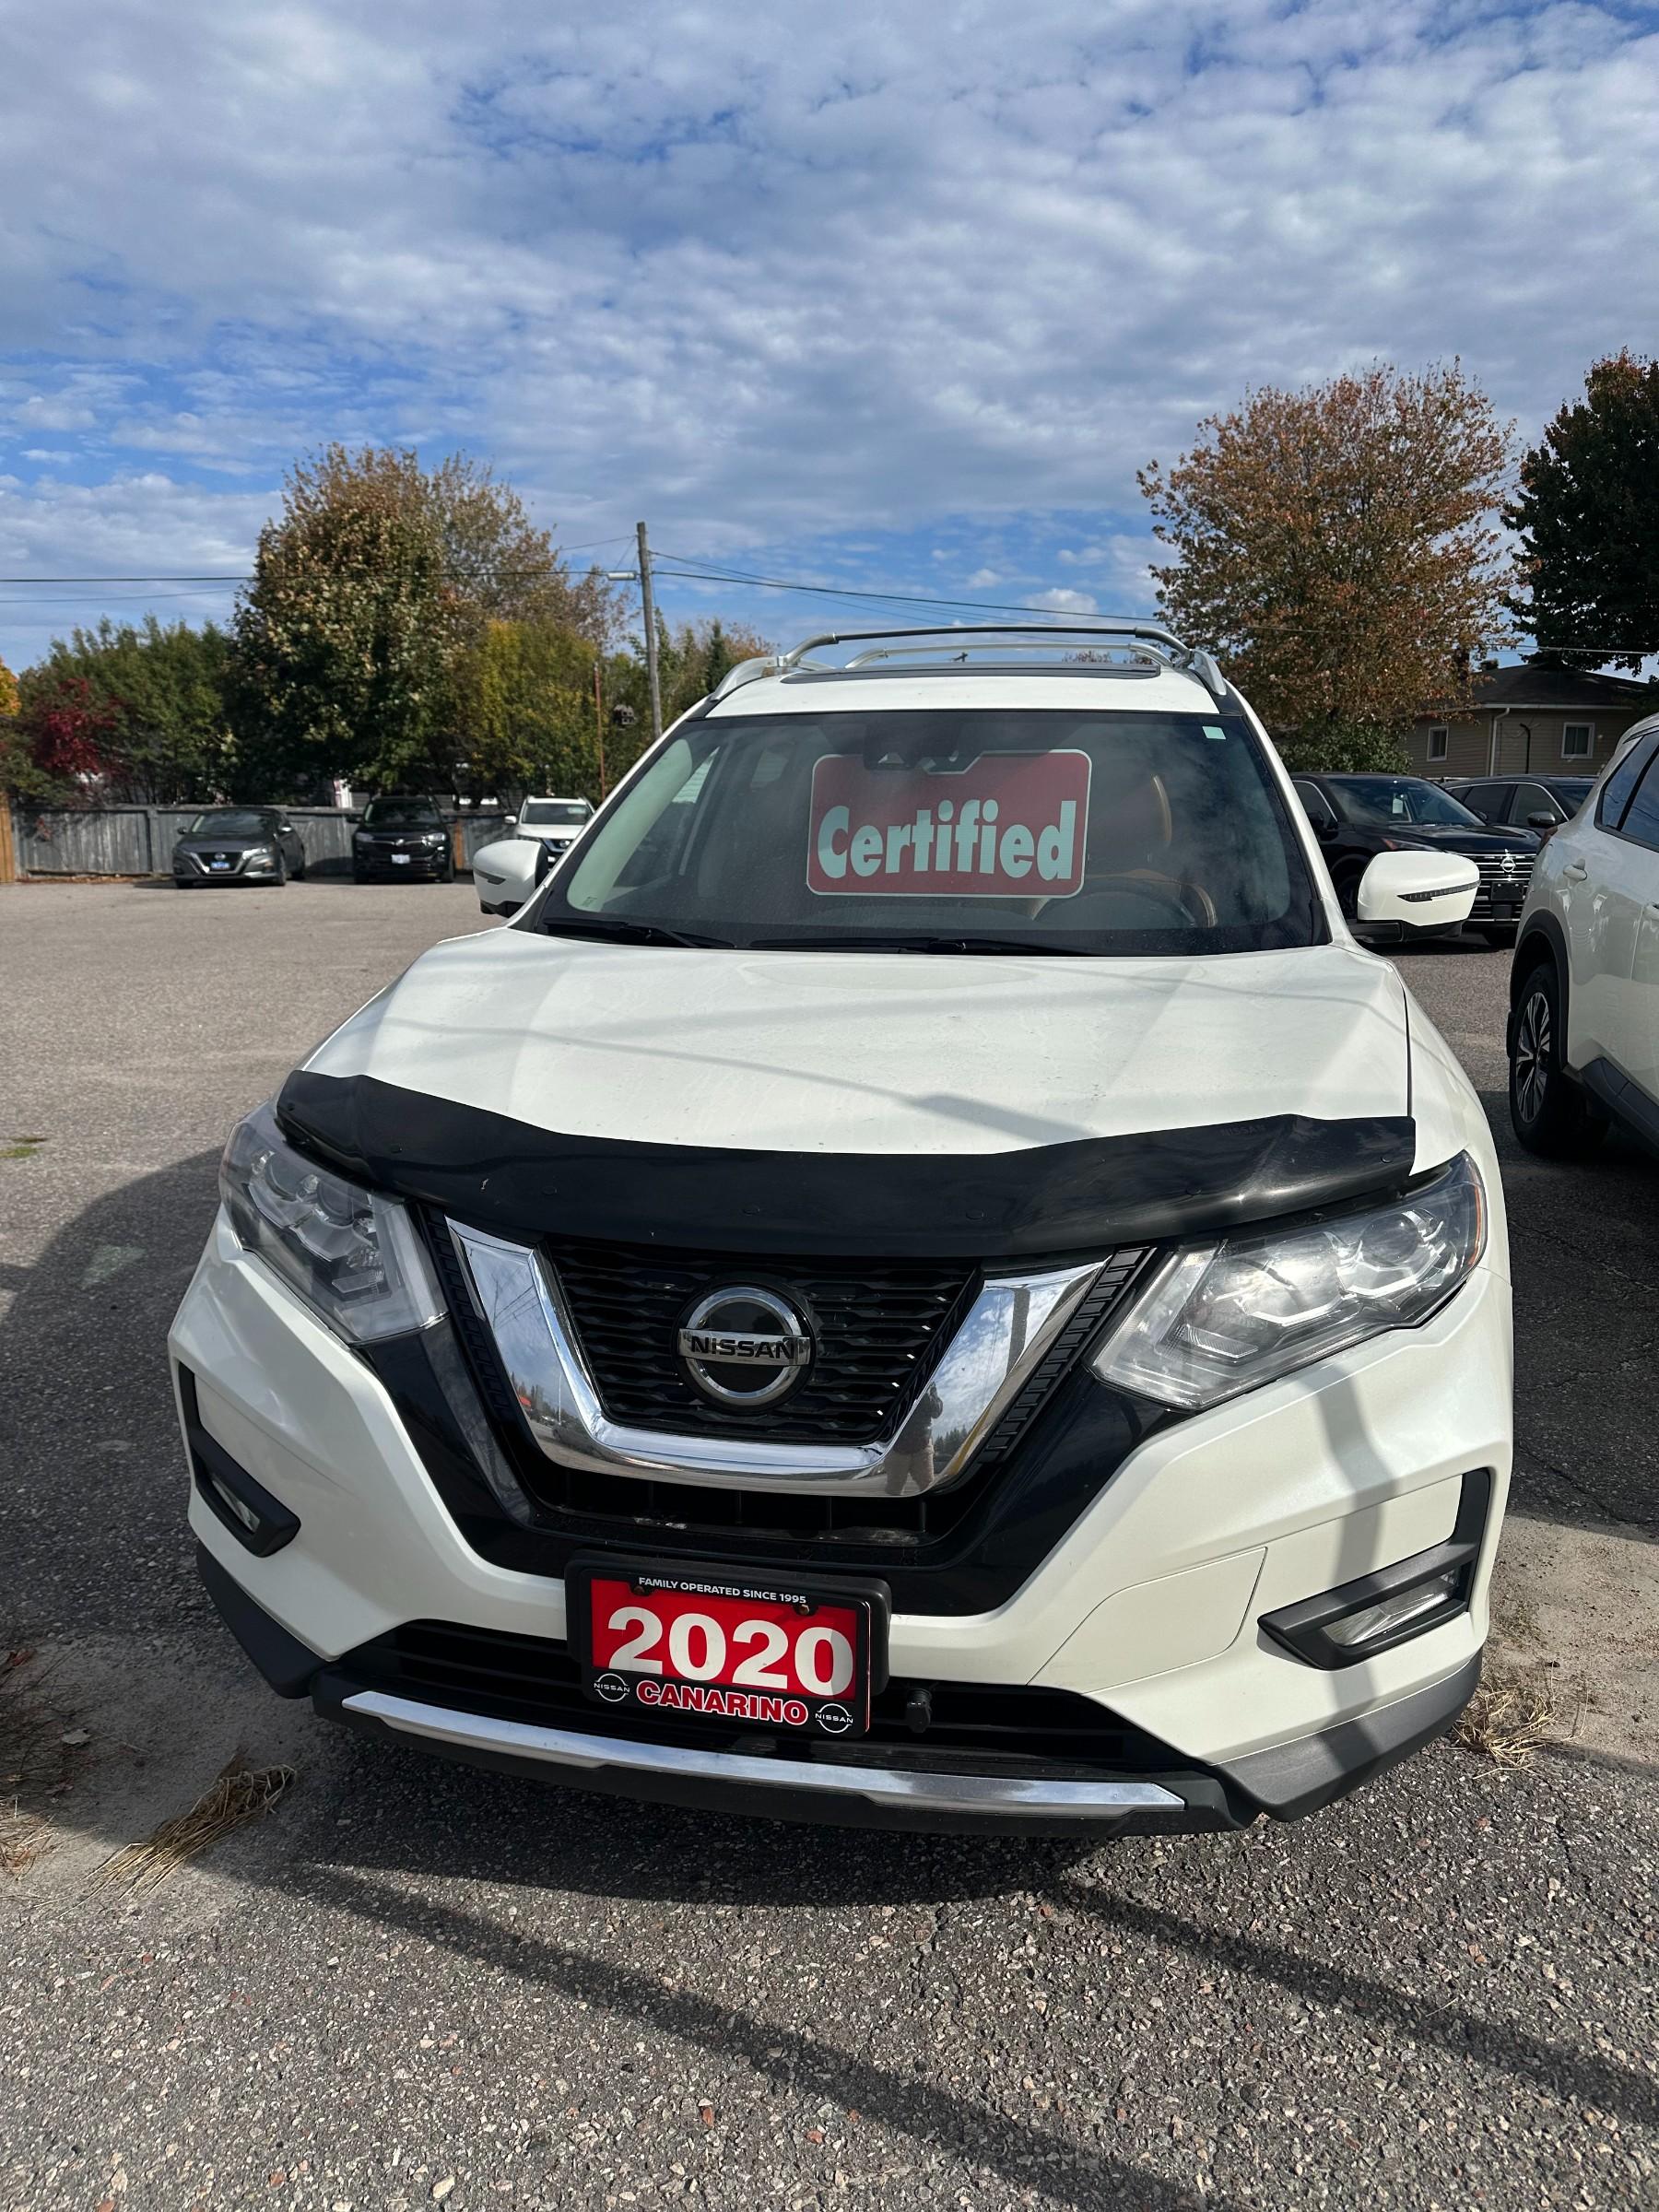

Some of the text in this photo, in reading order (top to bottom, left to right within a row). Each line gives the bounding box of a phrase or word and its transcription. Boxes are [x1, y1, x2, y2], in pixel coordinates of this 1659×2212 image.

[818, 799, 1077, 881] Certified
[691, 1335, 794, 1359] NISSAN
[639, 1577, 806, 1604] FAMILY OPERATED SINCE 1995
[607, 1606, 853, 1696] 2020
[594, 1682, 630, 1693] NISSAN
[636, 1680, 808, 1725] CANARINO
[815, 1712, 853, 1724] NISSAN
